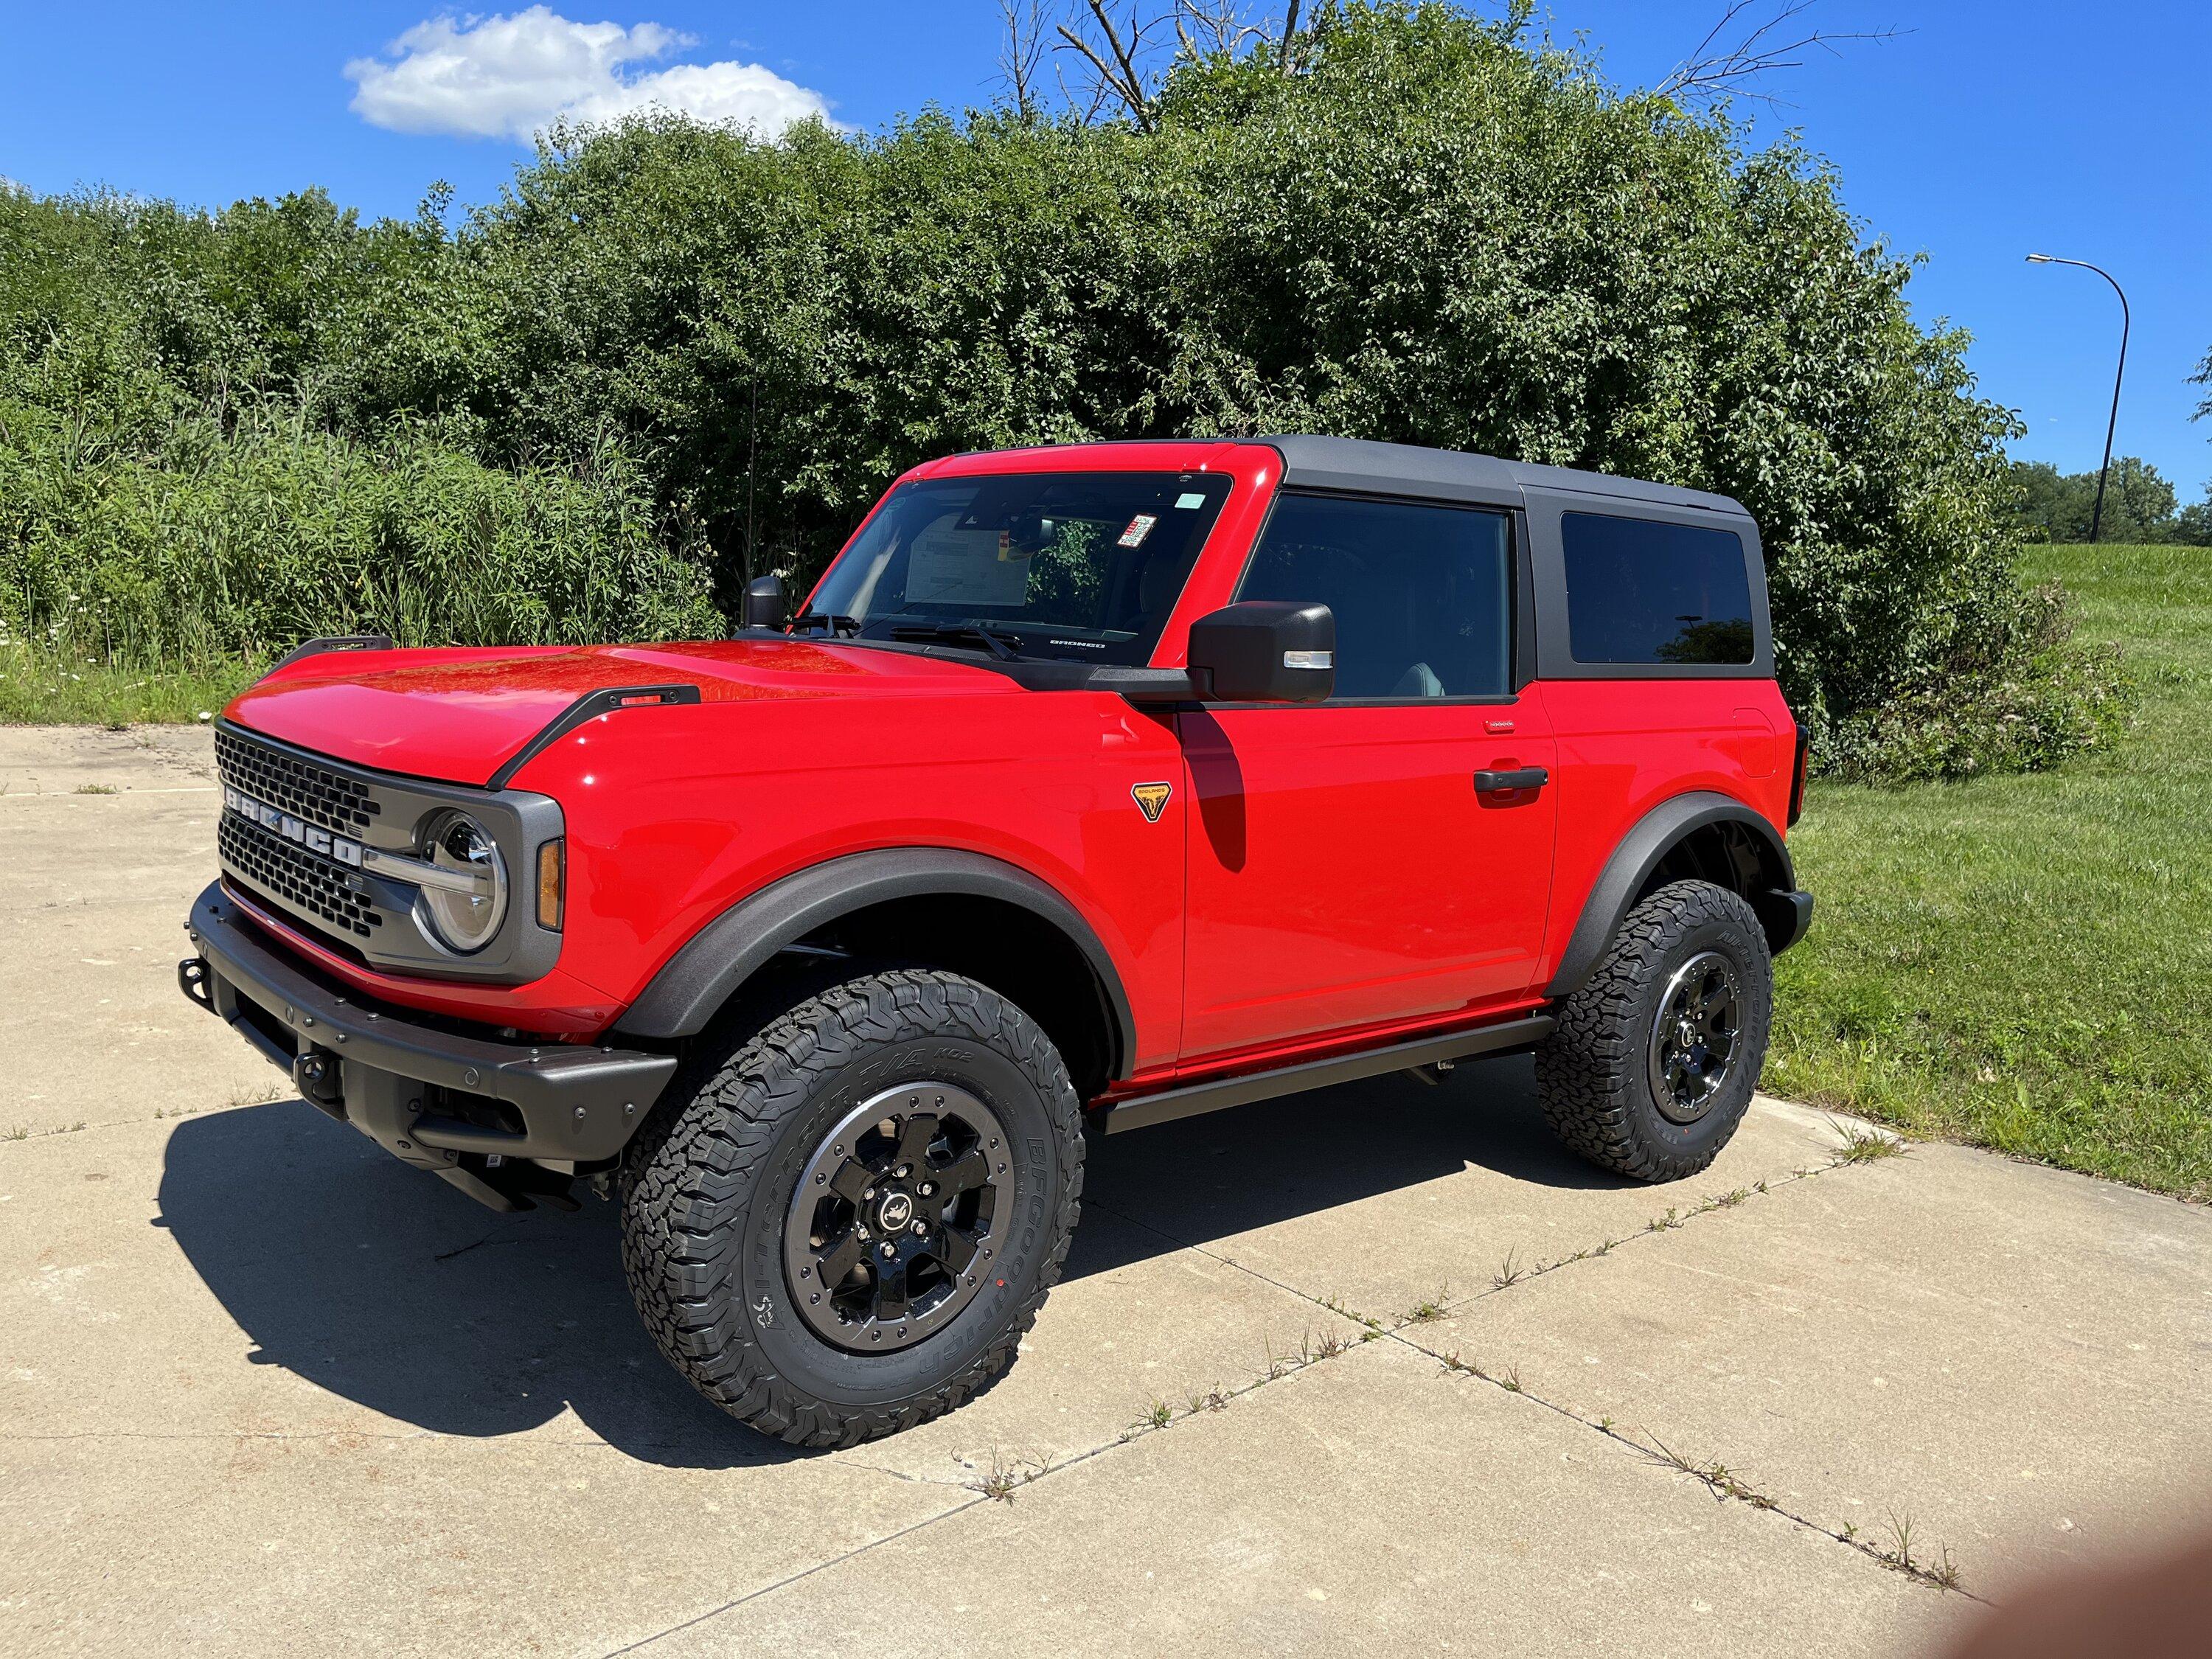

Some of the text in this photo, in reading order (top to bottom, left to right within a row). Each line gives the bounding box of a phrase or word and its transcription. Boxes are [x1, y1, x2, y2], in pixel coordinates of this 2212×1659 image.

[1049, 639, 1106, 649] BRONCO
[225, 785, 361, 867] BRONCO
[919, 1137, 1048, 1375] BFGoodrich
